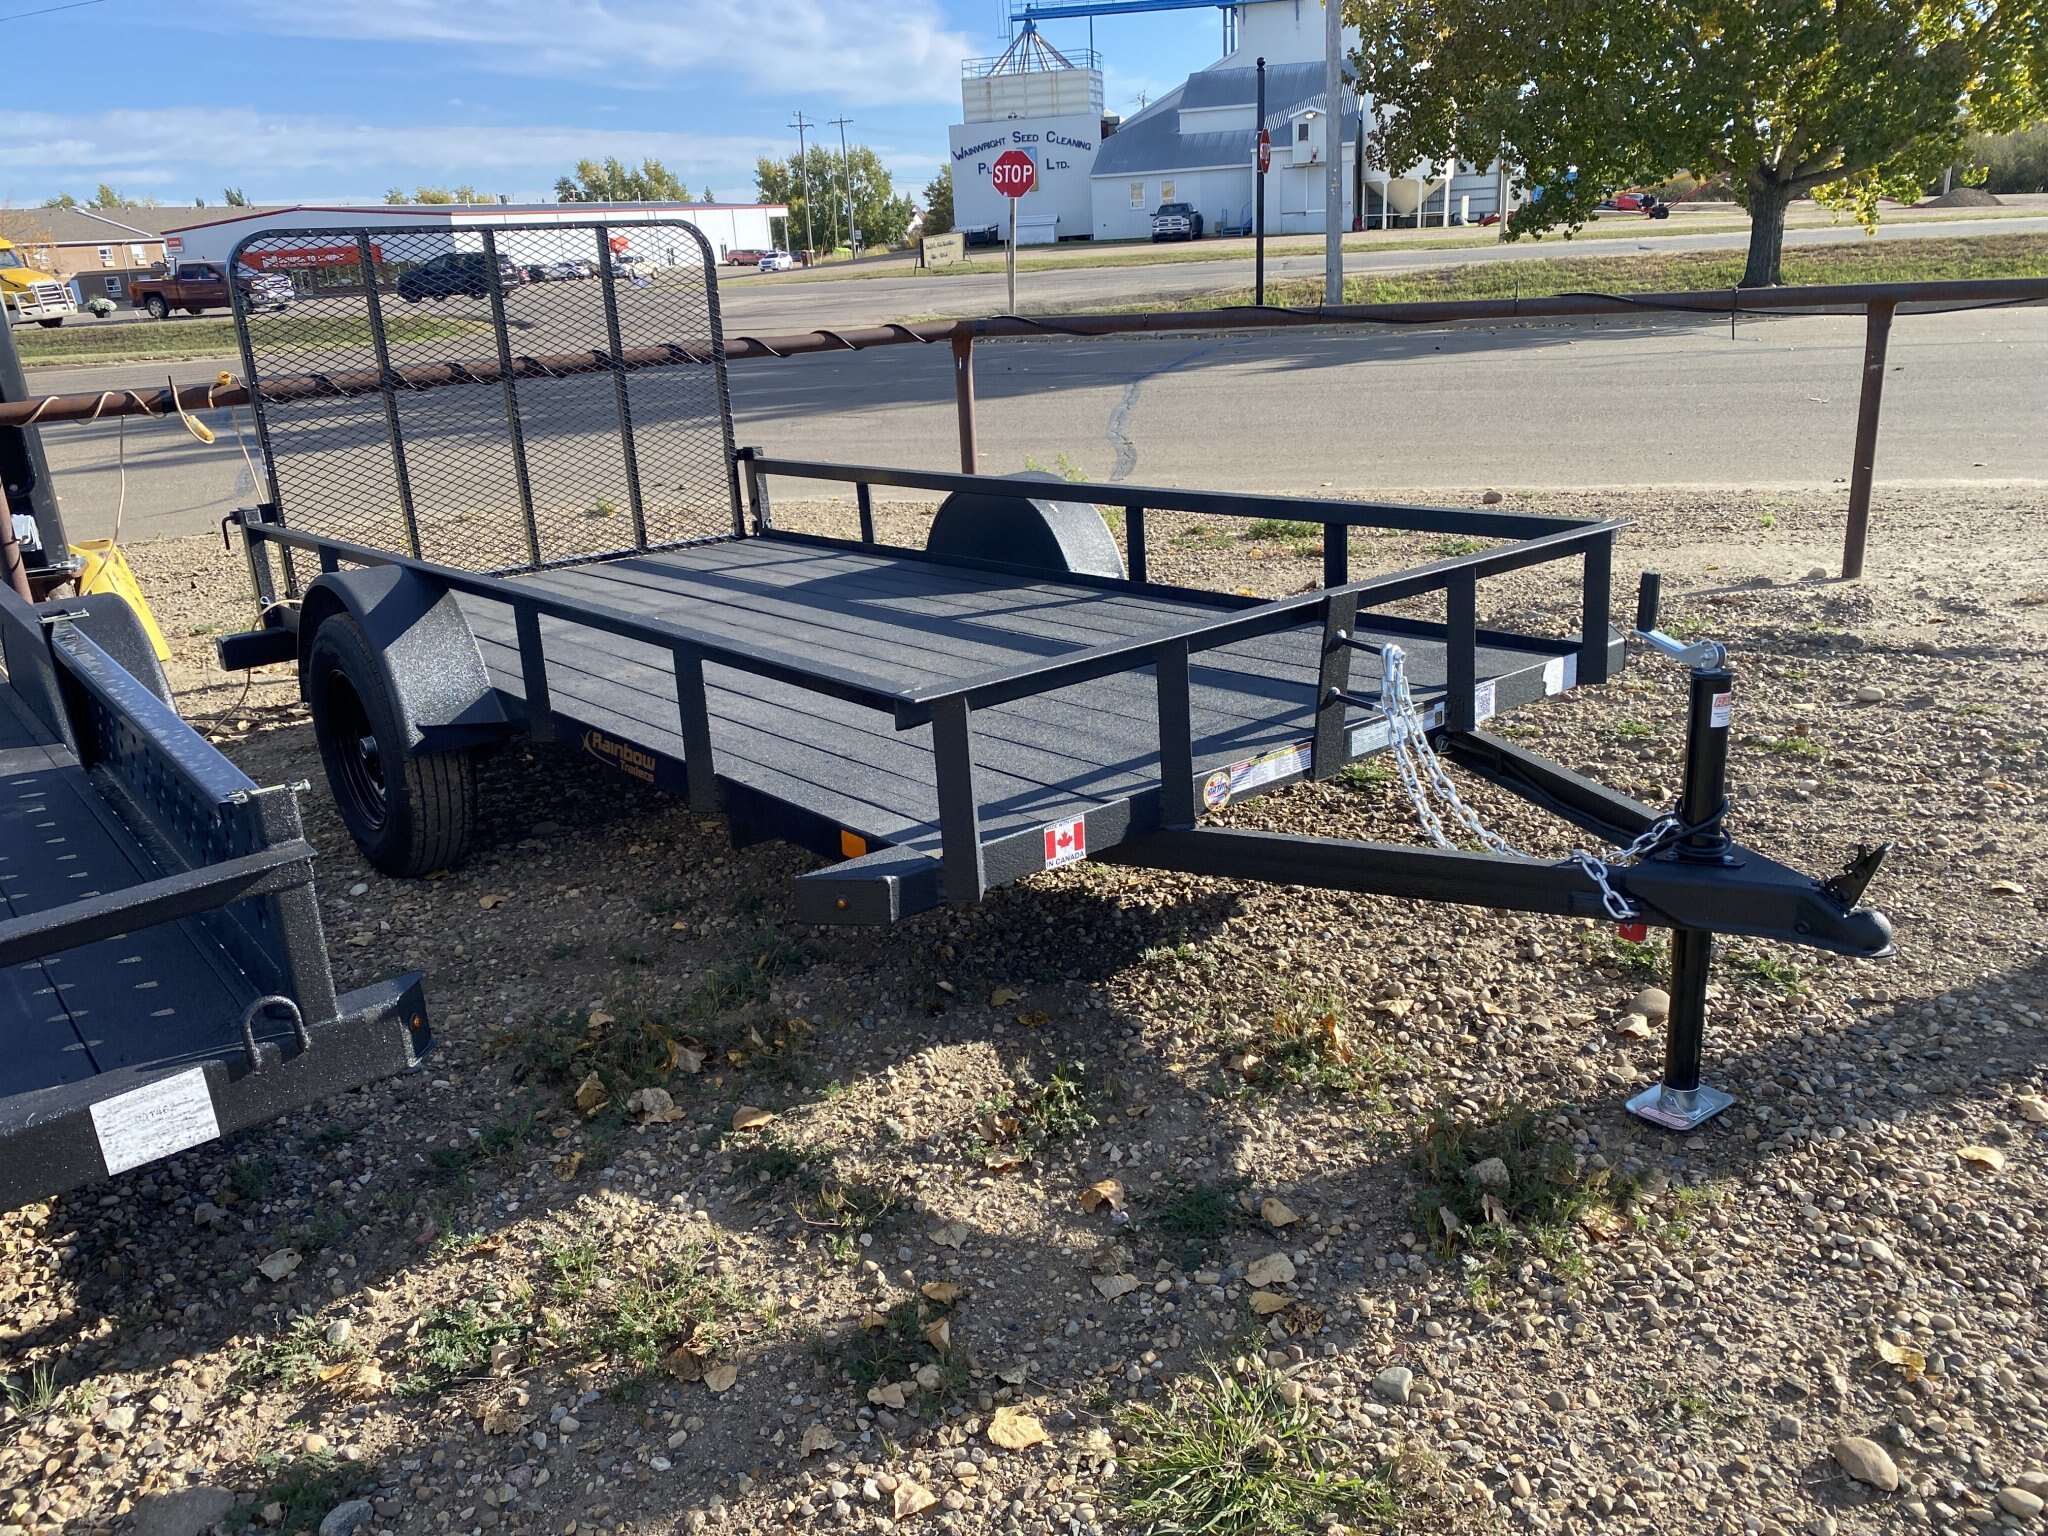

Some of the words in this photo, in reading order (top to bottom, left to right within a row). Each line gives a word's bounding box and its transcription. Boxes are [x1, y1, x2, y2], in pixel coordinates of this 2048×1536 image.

[952, 137, 1006, 161] WAINWRIGHT
[1012, 131, 1039, 143] SEED
[1046, 131, 1092, 151] CLEANING
[994, 164, 1033, 184] STOP
[1046, 158, 1070, 170] LTD.
[592, 731, 656, 771] Rainbow
[1046, 860, 1054, 868] IN
[1055, 850, 1085, 866] CANADA
